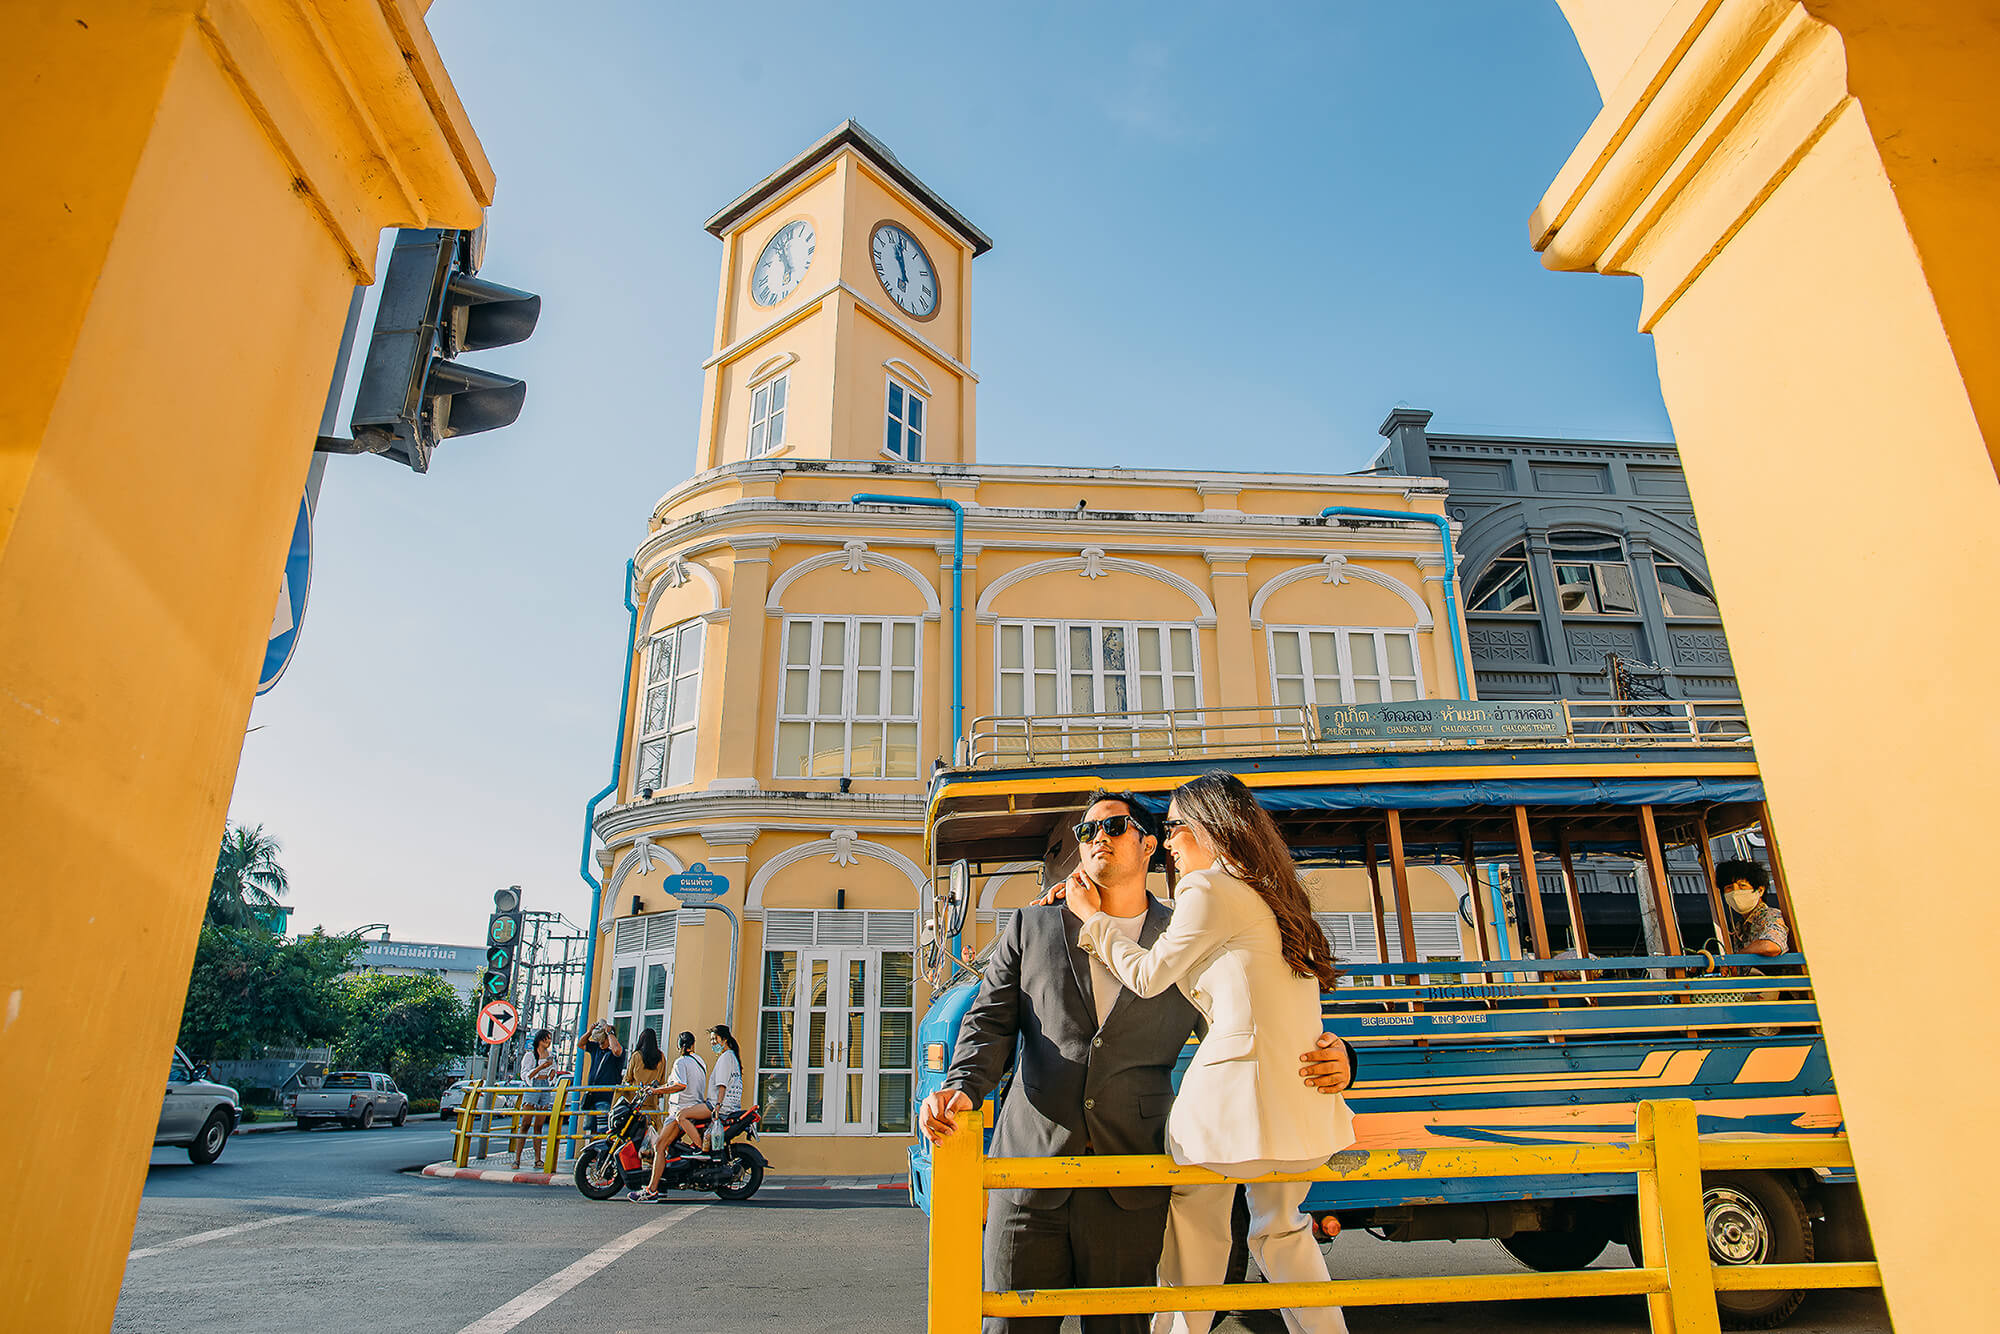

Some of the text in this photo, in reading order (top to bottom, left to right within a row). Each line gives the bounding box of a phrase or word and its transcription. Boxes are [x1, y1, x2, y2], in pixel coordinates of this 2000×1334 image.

[1378, 706, 1432, 722] วัดฉลอง
[1440, 705, 1486, 721] ห้าแยก
[1326, 723, 1557, 736] PHUKET TOWN CHALONG BAY CHALONG CIRCLE CHALONG TEMPLE
[493, 919, 515, 940] 27
[1428, 985, 1524, 1000] BIG BUDDHA
[1362, 1016, 1414, 1026] BIG BUDDHA
[1432, 1014, 1487, 1024] KING POWER
